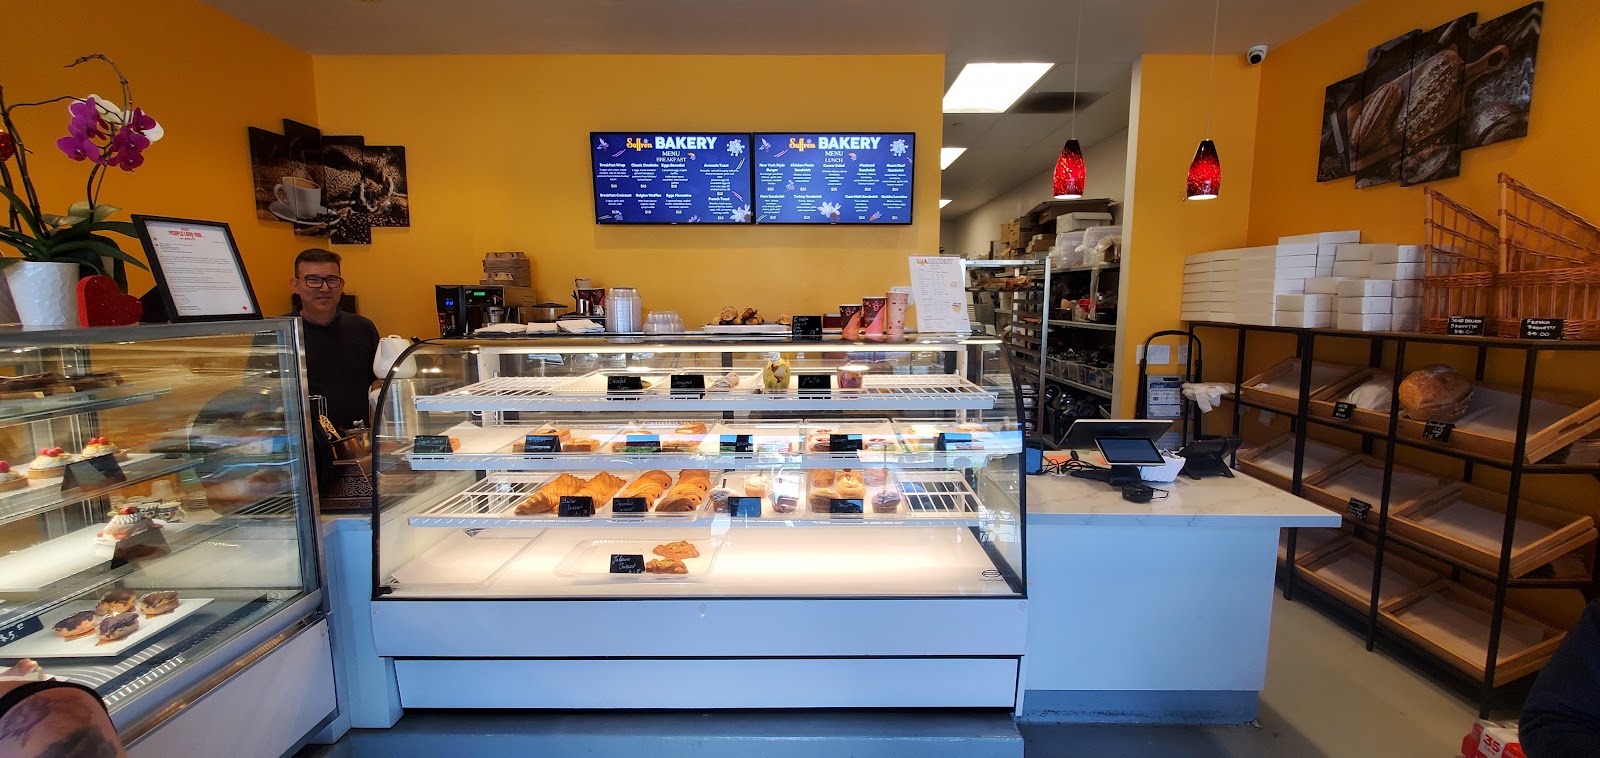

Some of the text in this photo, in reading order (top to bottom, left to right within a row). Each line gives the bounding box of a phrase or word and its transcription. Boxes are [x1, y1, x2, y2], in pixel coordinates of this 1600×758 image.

[655, 136, 717, 149] BAKERY
[818, 136, 881, 149] BAKERY
[1483, 733, 1501, 753] 35
